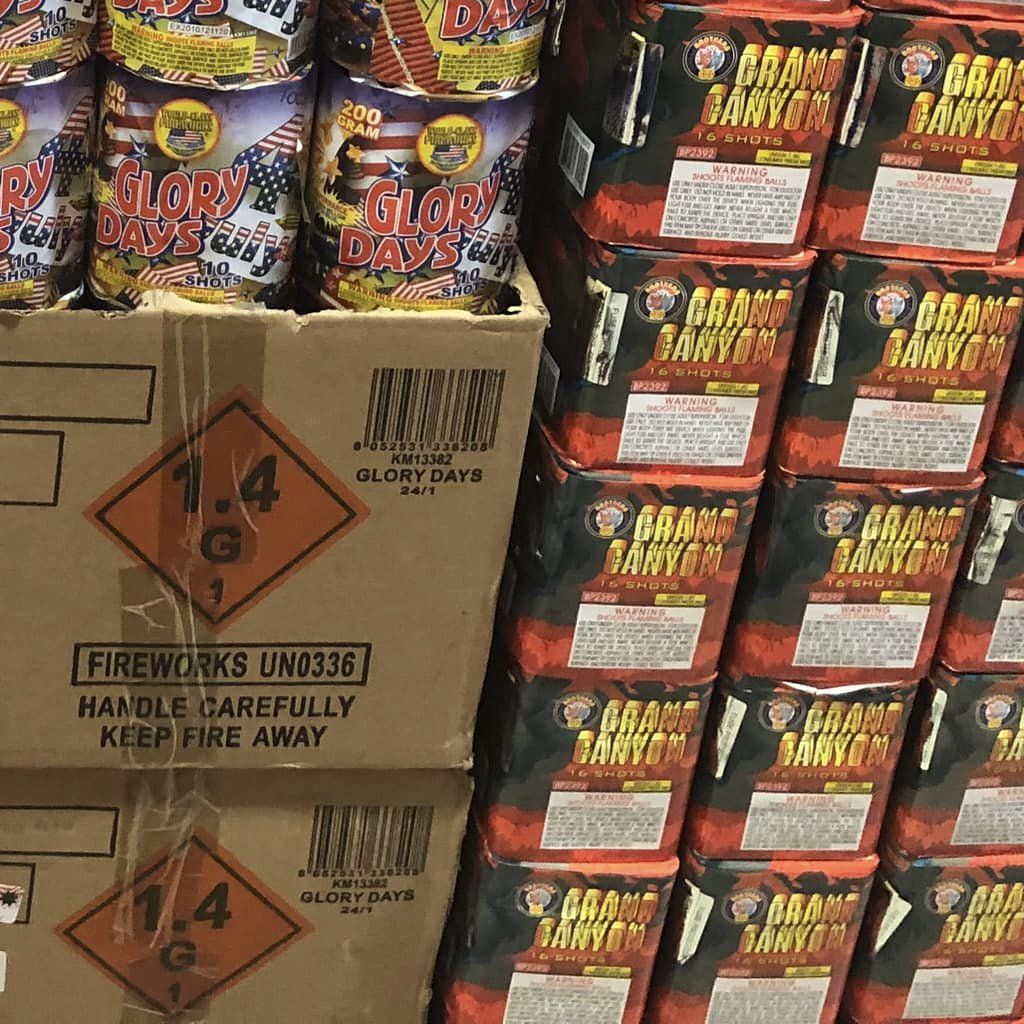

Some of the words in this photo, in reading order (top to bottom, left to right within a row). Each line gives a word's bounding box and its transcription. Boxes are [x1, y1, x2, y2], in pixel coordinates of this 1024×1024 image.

[43, 6, 67, 26] 10
[29, 18, 76, 45] SHOTS
[734, 42, 848, 92] GRAND
[341, 98, 383, 125] 200
[699, 83, 833, 132] CANYON
[336, 114, 382, 141] GRAM
[696, 131, 718, 143] 16
[723, 133, 784, 147] SHOTS
[711, 164, 769, 179] WARNING
[114, 158, 250, 221] GLORY
[364, 171, 501, 236] GLORY
[95, 203, 205, 258] DAYS
[12, 251, 39, 268] 10
[338, 226, 462, 273] DAYS
[184, 273, 242, 289] SHOTS
[201, 260, 231, 277] 10
[457, 267, 480, 284] 10
[684, 285, 793, 328] GRAND
[914, 289, 1023, 335] GRAND
[650, 322, 778, 366] CANYON
[881, 327, 1007, 372] CANYON
[648, 366, 669, 377] 16
[674, 367, 732, 380] SHOTS
[664, 396, 718, 408] WARNING
[391, 453, 453, 466] KM13382
[171, 454, 280, 515] 1.4
[356, 467, 427, 484] GLORY
[429, 468, 483, 484] DAYS
[399, 486, 436, 496] 24/1
[633, 503, 741, 542] GRAND
[861, 503, 966, 542] GRAND
[199, 524, 243, 564] G
[605, 539, 726, 577] CANYON
[830, 538, 951, 576] CANYON
[208, 576, 225, 605] 1
[614, 606, 667, 617] WARNING
[87, 650, 249, 679] FIREWORKS
[260, 651, 357, 679] UN0336
[78, 694, 188, 720] HANDLE
[199, 694, 357, 720] CAREFULLY
[599, 698, 702, 735] GRAND
[98, 724, 172, 749] KEEP
[182, 725, 241, 749] FIRE
[252, 724, 327, 748] AWAY
[572, 729, 688, 766] CANYON
[135, 881, 233, 932] 1.4
[300, 890, 365, 904] GLORY
[367, 888, 416, 904] DAYS
[159, 939, 197, 972] G
